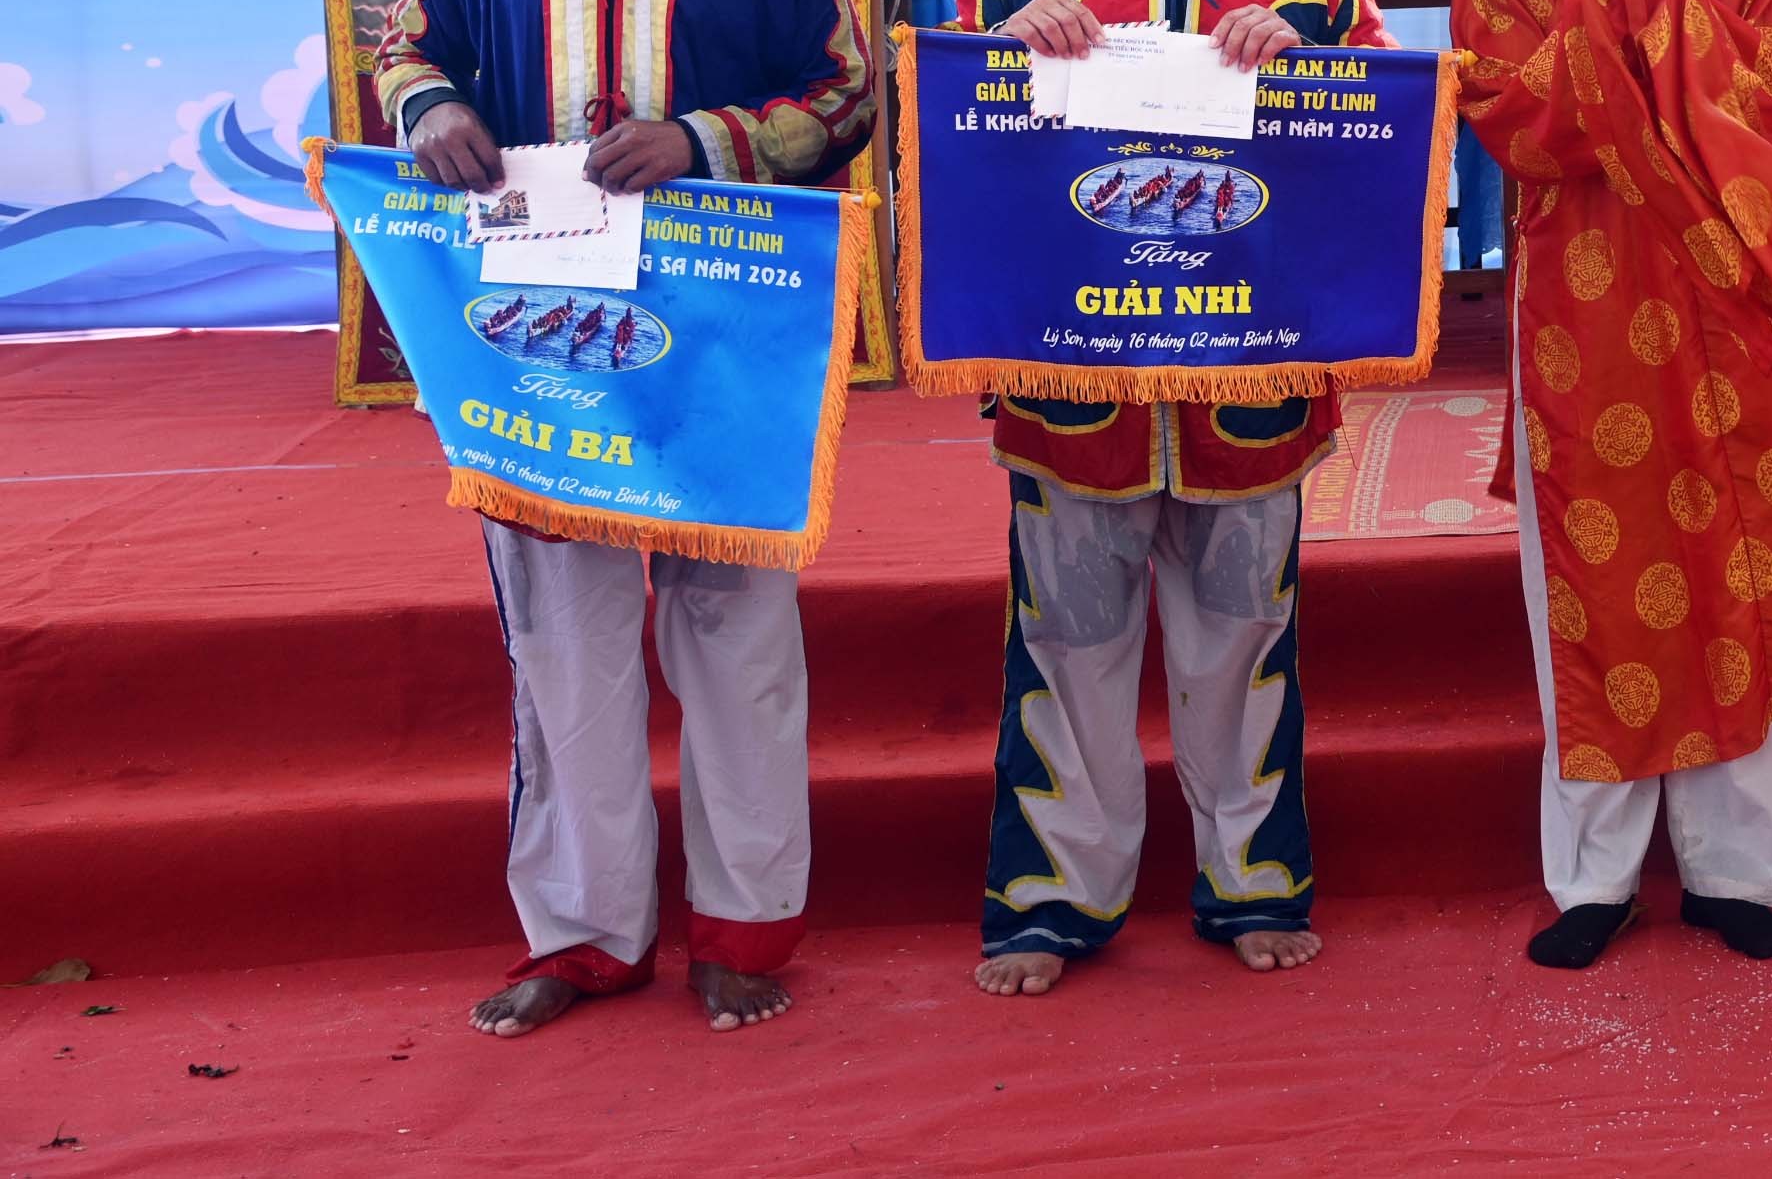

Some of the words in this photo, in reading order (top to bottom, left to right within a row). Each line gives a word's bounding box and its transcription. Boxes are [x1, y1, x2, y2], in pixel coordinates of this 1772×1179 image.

[1293, 59, 1326, 78] AN
[1329, 56, 1368, 80] HẢI
[975, 76, 1017, 103] GIẢI
[1255, 83, 1297, 111] ỐNG
[1301, 87, 1329, 111] TỨ
[1331, 93, 1377, 113] LINH
[954, 107, 979, 132] LỄ
[1256, 118, 1283, 138] SA
[1288, 116, 1335, 140] NĂM
[1340, 122, 1395, 140] 2026
[395, 161, 429, 179] BA
[700, 194, 730, 214] AN
[736, 194, 774, 219] HẢI
[383, 186, 429, 212] GIẢI
[644, 214, 703, 245] HỐNG
[707, 224, 735, 249] TỨ
[738, 230, 785, 255] LINH
[353, 213, 381, 235] LỄ
[386, 220, 448, 245] KHAO
[659, 255, 688, 277] SA
[694, 256, 742, 282] NĂM
[747, 266, 803, 289] 2026
[1122, 239, 1214, 271] Tặng
[1074, 279, 1164, 317] GIẢI
[1174, 278, 1253, 316] NHÌ
[1042, 327, 1061, 349] Lý
[1062, 328, 1087, 349] Sơn,
[1089, 332, 1124, 354] ngày
[1128, 332, 1146, 349] 16
[1147, 332, 1187, 354] tháng
[1189, 332, 1208, 349] 02
[1209, 332, 1240, 349] năm
[1242, 329, 1273, 348] Bính
[1274, 327, 1301, 349] Ngọ
[511, 372, 610, 411] Tặng
[458, 398, 557, 453] GIẢI
[566, 428, 635, 467] BA
[462, 446, 497, 469] ngày
[500, 457, 518, 475] 16
[517, 465, 555, 491] tháng
[557, 475, 580, 495] 02
[578, 484, 613, 503] năm
[613, 486, 651, 508] Bính
[650, 491, 683, 515] Ngọ
